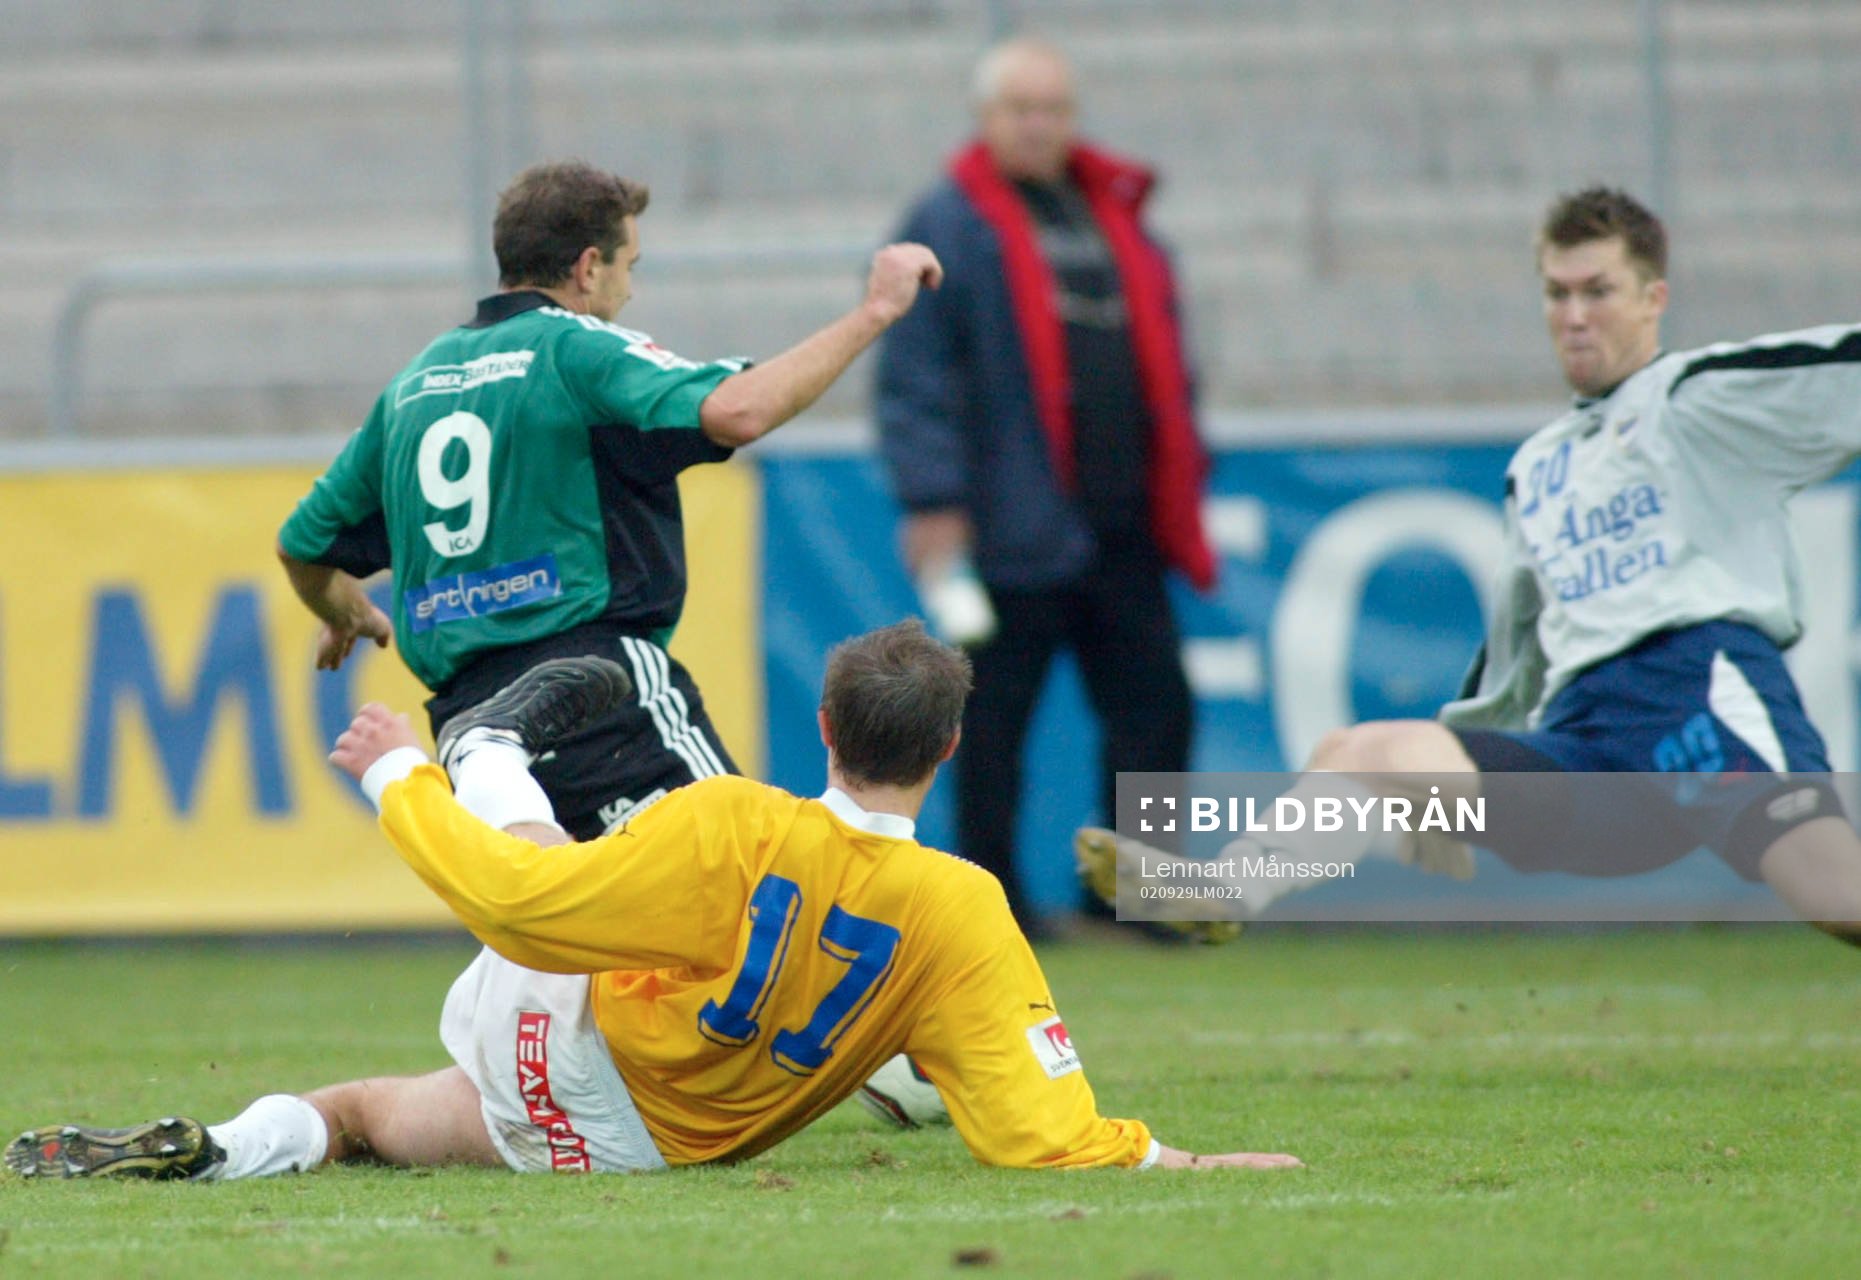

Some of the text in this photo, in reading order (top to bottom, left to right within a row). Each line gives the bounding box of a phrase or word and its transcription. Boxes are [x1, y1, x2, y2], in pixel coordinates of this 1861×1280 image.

[418, 411, 492, 557] 9
[449, 537, 474, 552] ICA
[698, 872, 902, 1077] 17
